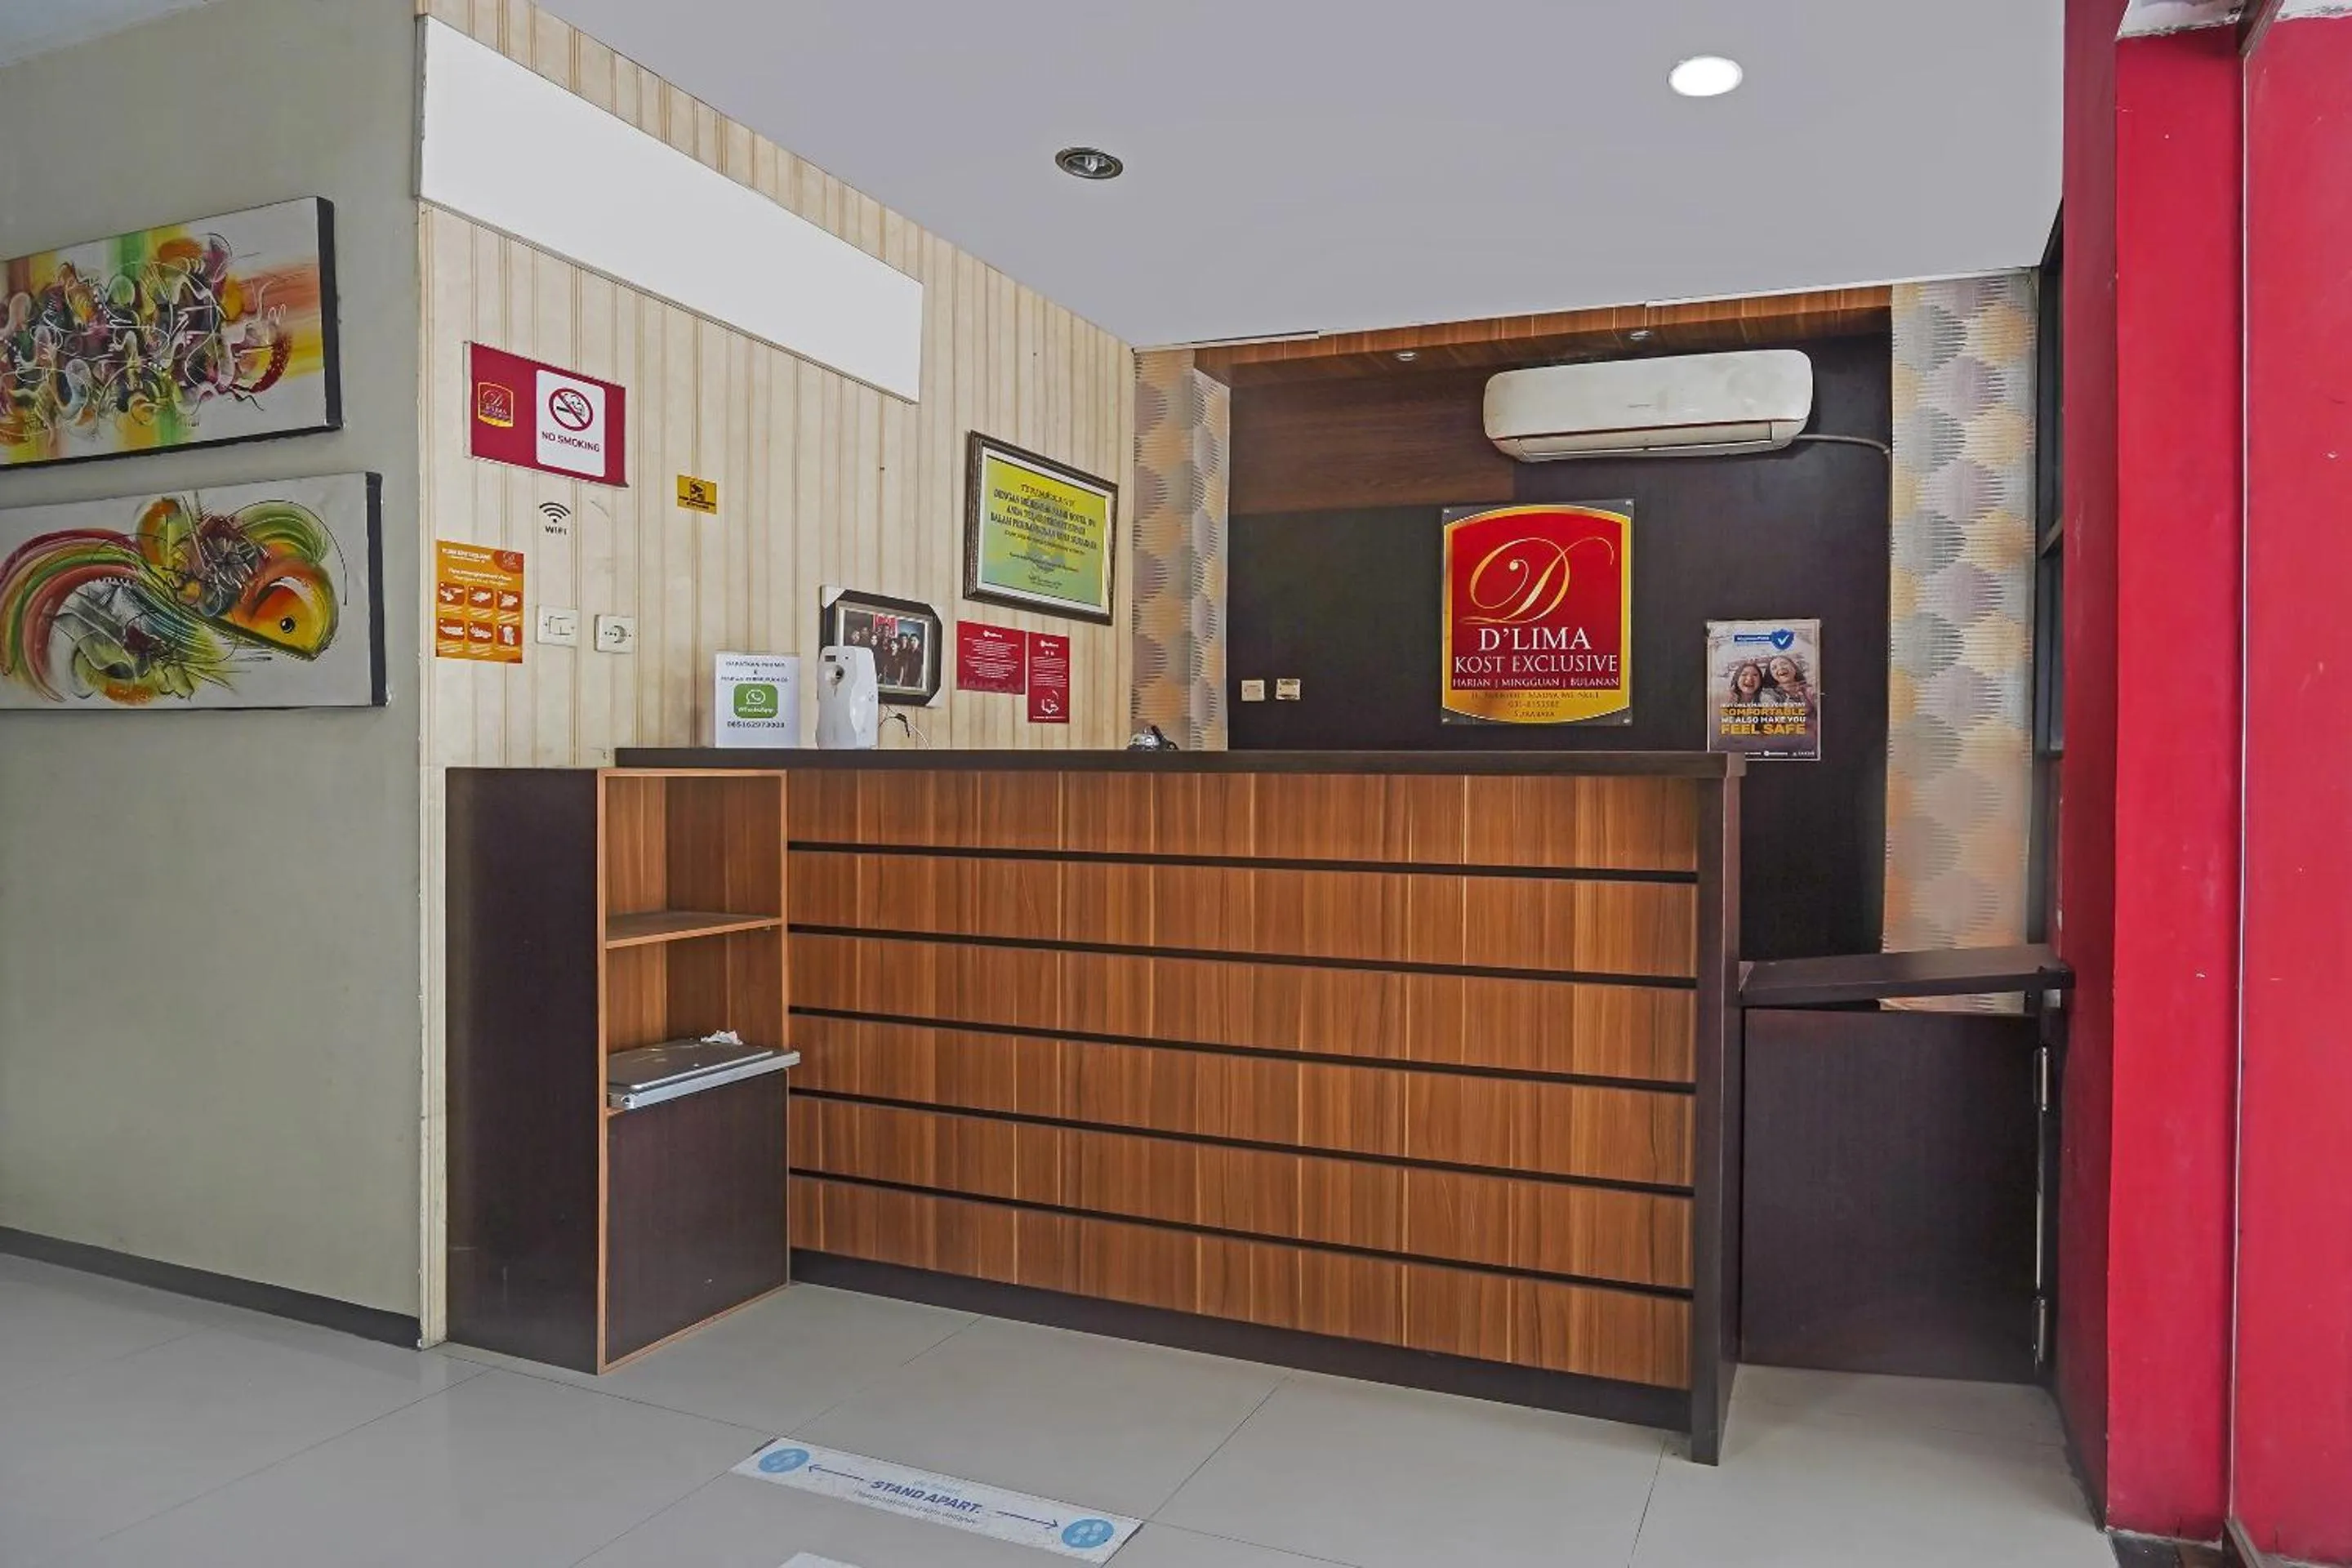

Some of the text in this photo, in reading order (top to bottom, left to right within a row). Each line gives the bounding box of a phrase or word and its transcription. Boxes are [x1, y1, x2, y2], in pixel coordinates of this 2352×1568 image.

[541, 431, 600, 452] NO SMOKING
[1477, 626, 1592, 651] D'LIMA
[1454, 654, 1619, 674] KOST EXCLUSIVE
[1453, 678, 1491, 688] HARIAN
[1500, 677, 1560, 688] MINGGUAN
[1570, 677, 1619, 687] BULANAN
[1720, 707, 1806, 716] COMFORTABLE
[1786, 715, 1806, 724] YOU
[1721, 724, 1806, 735] FEEL SAFE
[871, 1480, 925, 1499] STAND
[923, 1493, 982, 1514] APART.
